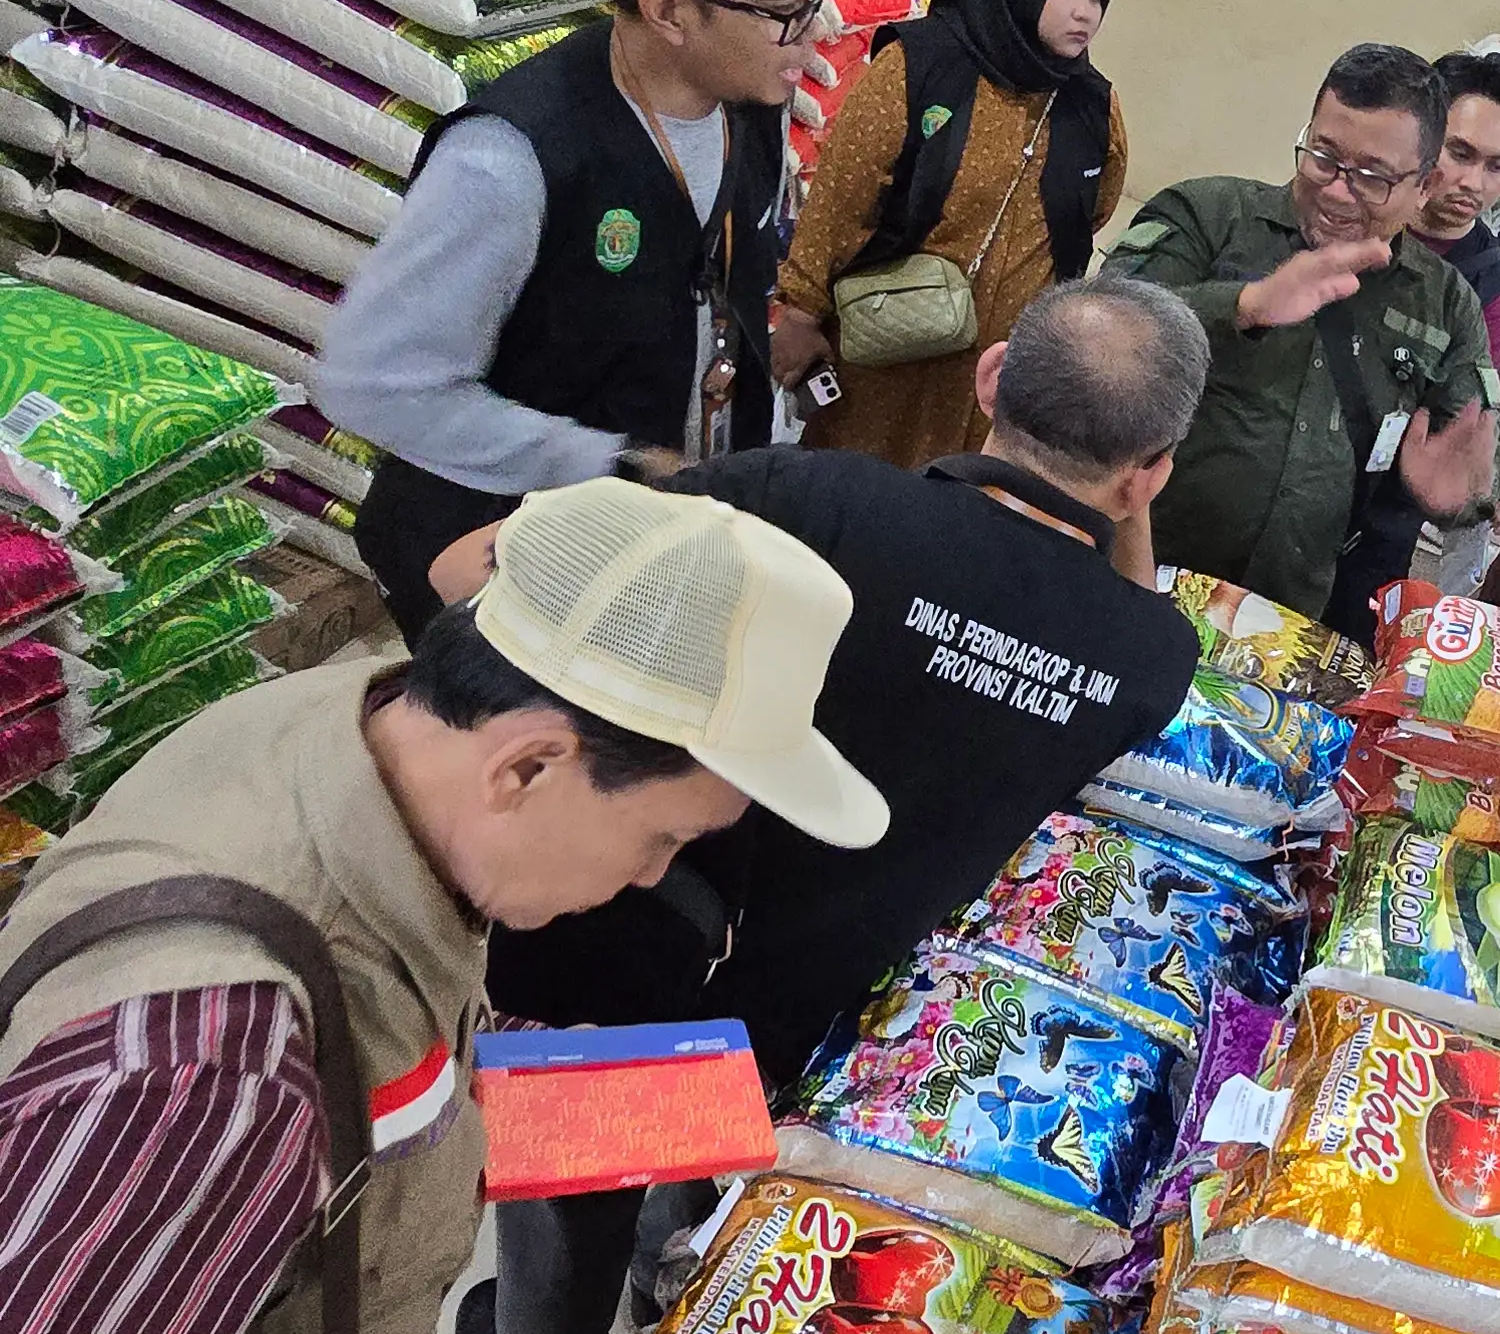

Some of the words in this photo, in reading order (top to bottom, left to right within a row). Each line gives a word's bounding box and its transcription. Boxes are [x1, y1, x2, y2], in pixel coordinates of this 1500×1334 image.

[904, 597, 961, 643] DINAS
[959, 618, 1072, 693] PERINDAGKOP
[1069, 664, 1087, 695] &
[1084, 670, 1120, 707] UKM
[925, 644, 1013, 703] PROVINSI
[1009, 678, 1078, 727] KALTIM
[1389, 832, 1445, 951] Melon
[918, 1023, 978, 1118] Kupu
[966, 977, 1029, 1080] Kupu
[1350, 1051, 1432, 1180] Hati
[739, 1205, 791, 1277] Pilihan
[798, 1201, 852, 1254] 2
[704, 1274, 746, 1326] Hati
